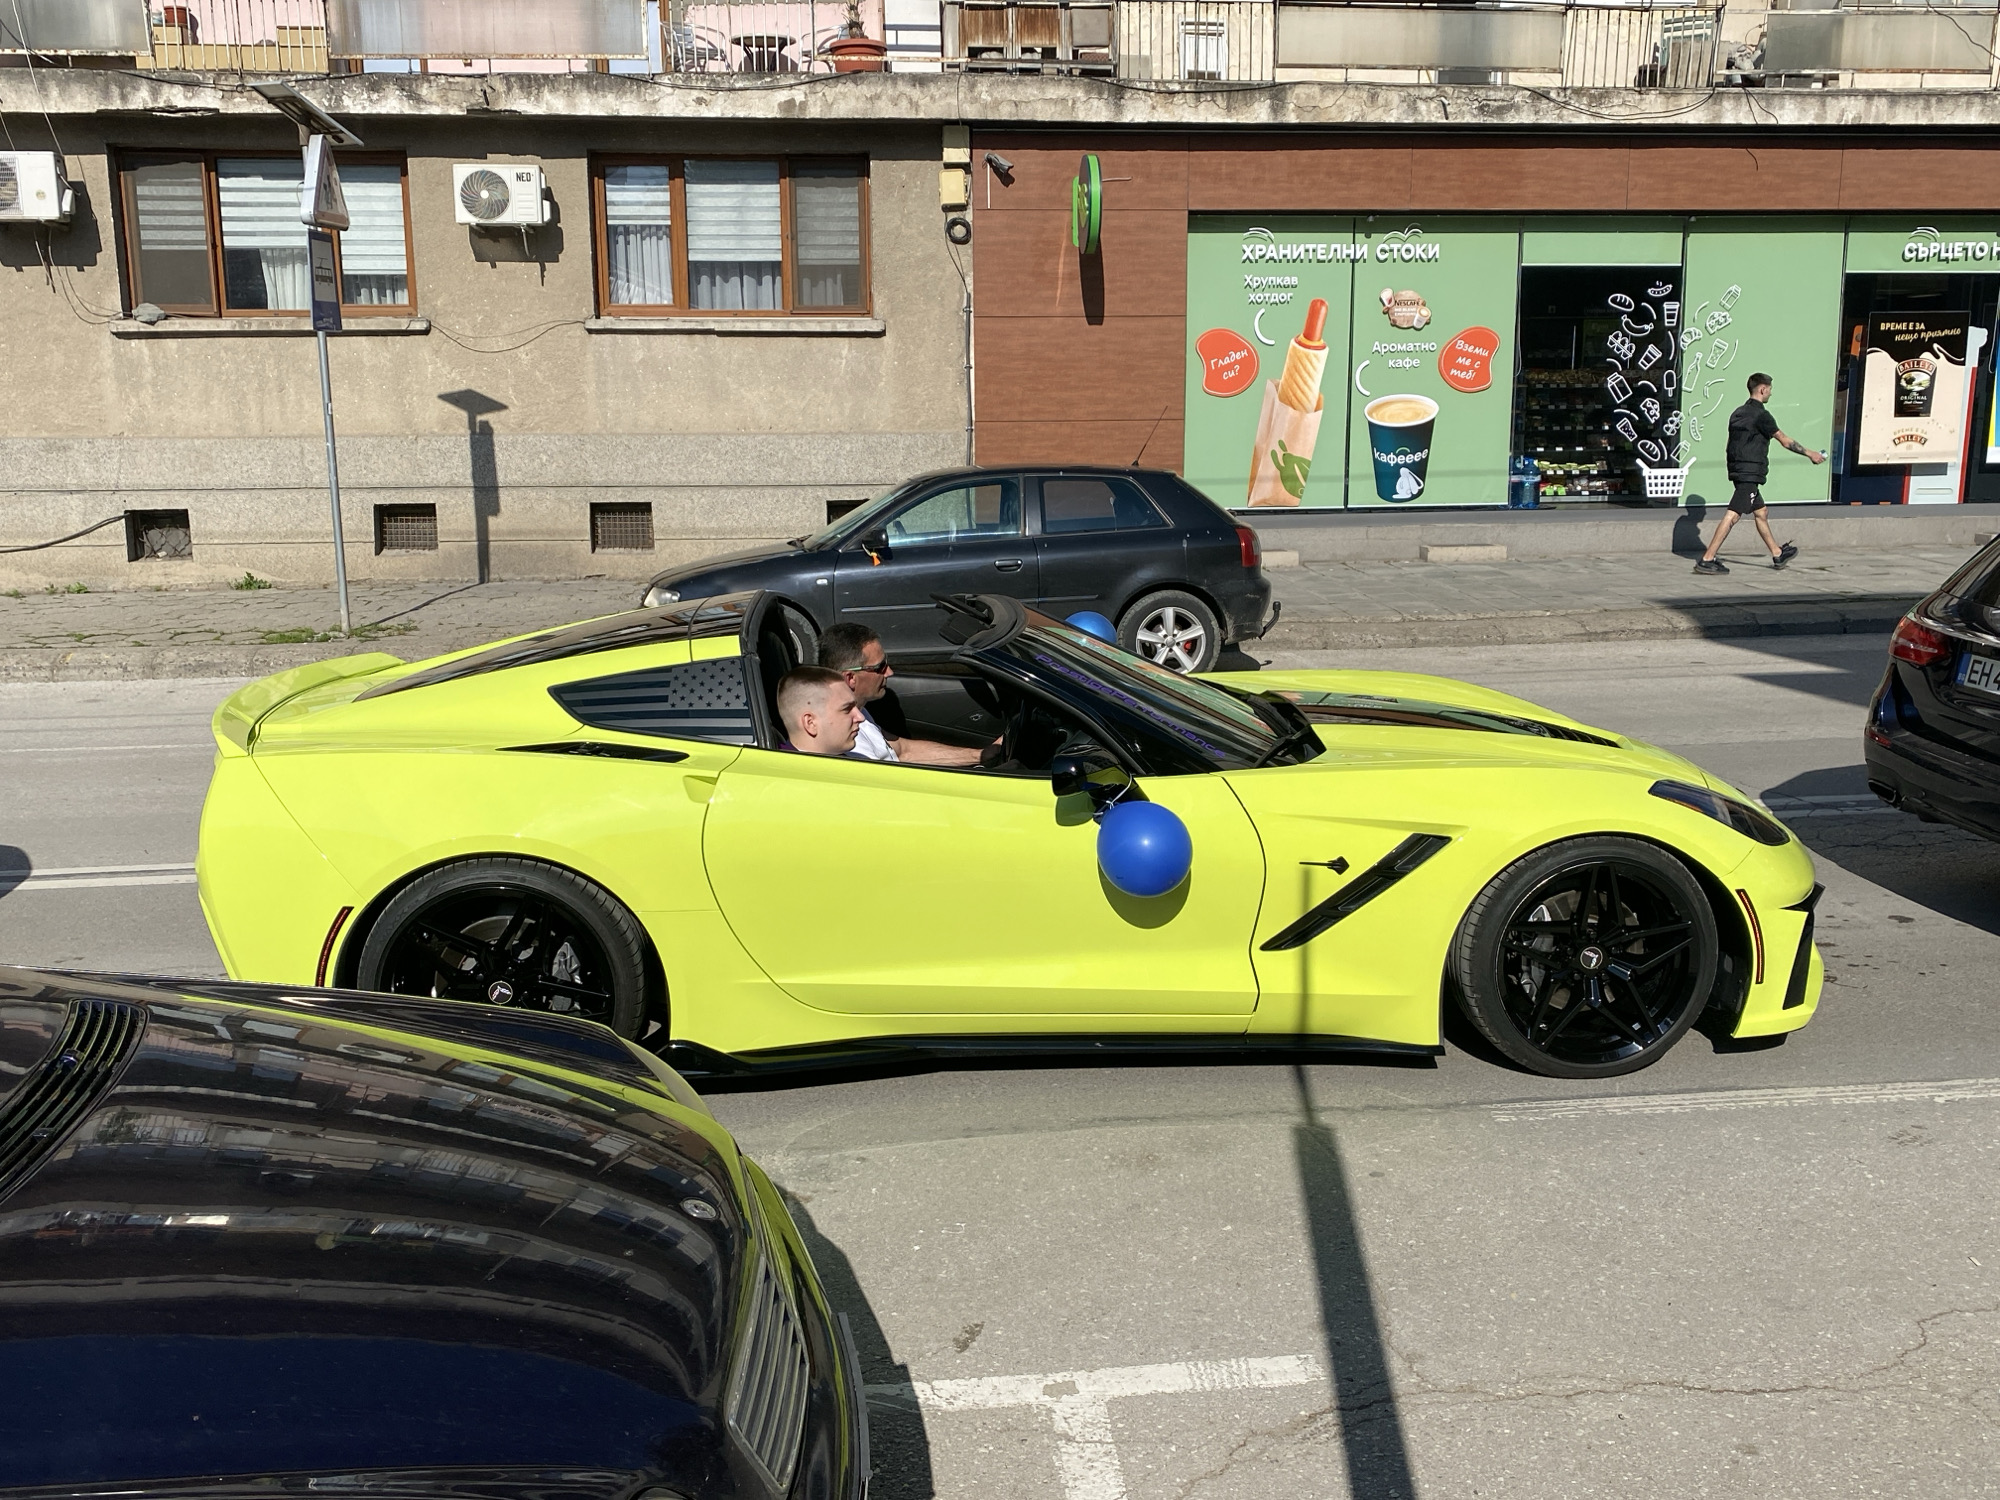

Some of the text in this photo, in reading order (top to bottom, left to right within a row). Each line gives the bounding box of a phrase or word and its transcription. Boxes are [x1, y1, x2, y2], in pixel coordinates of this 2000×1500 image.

[515, 172, 532, 182] NEO
[1241, 243, 1441, 261] ХРАНИТЕЛНИ СТОКИ
[1904, 241, 1989, 260] СЪРЦЕТО
[1243, 274, 1299, 290] Хрупкав
[1248, 292, 1295, 304] хотдог
[1880, 322, 1907, 331] ВРЕМЕ
[1915, 322, 1926, 330] ЗА
[1894, 327, 1962, 343] нещо приятно
[1371, 341, 1437, 356] Ароматно
[1455, 339, 1490, 357] Вземи
[1210, 348, 1249, 371] Гладен
[1388, 356, 1421, 370] кафе
[1455, 355, 1481, 369] ме с
[1899, 360, 1934, 373] BAILEYS
[1222, 364, 1240, 380] си?
[1450, 367, 1476, 381] теб!
